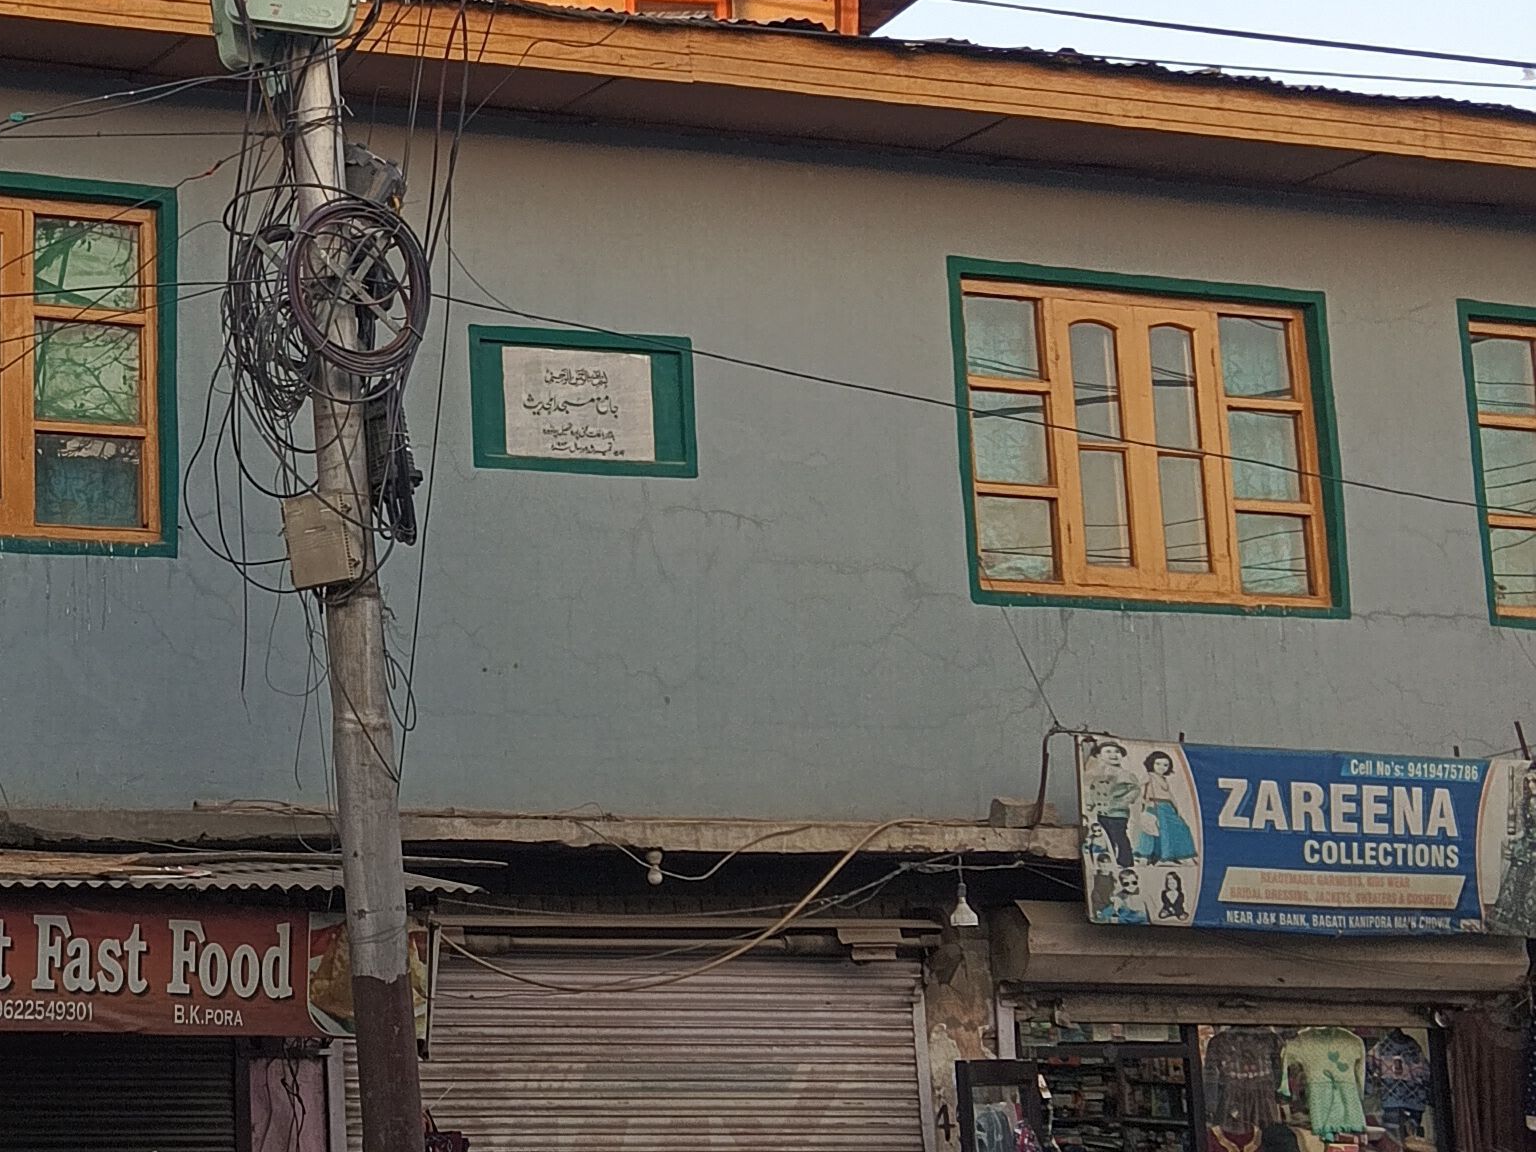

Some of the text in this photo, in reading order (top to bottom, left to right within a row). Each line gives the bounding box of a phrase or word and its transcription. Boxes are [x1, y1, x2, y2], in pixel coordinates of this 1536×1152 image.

[1350, 759, 1479, 780] Cell No's: 9419475786
[1217, 777, 1459, 838] ZAREENA
[1303, 839, 1460, 868] COLLECTIONS
[1226, 910, 1253, 924] NEAR
[1256, 911, 1276, 925] J&K
[1349, 916, 1392, 928] KANIPORA
[33, 914, 148, 996] Fast
[167, 919, 294, 1000] Food
[174, 1004, 244, 1027] B.K.PORA
